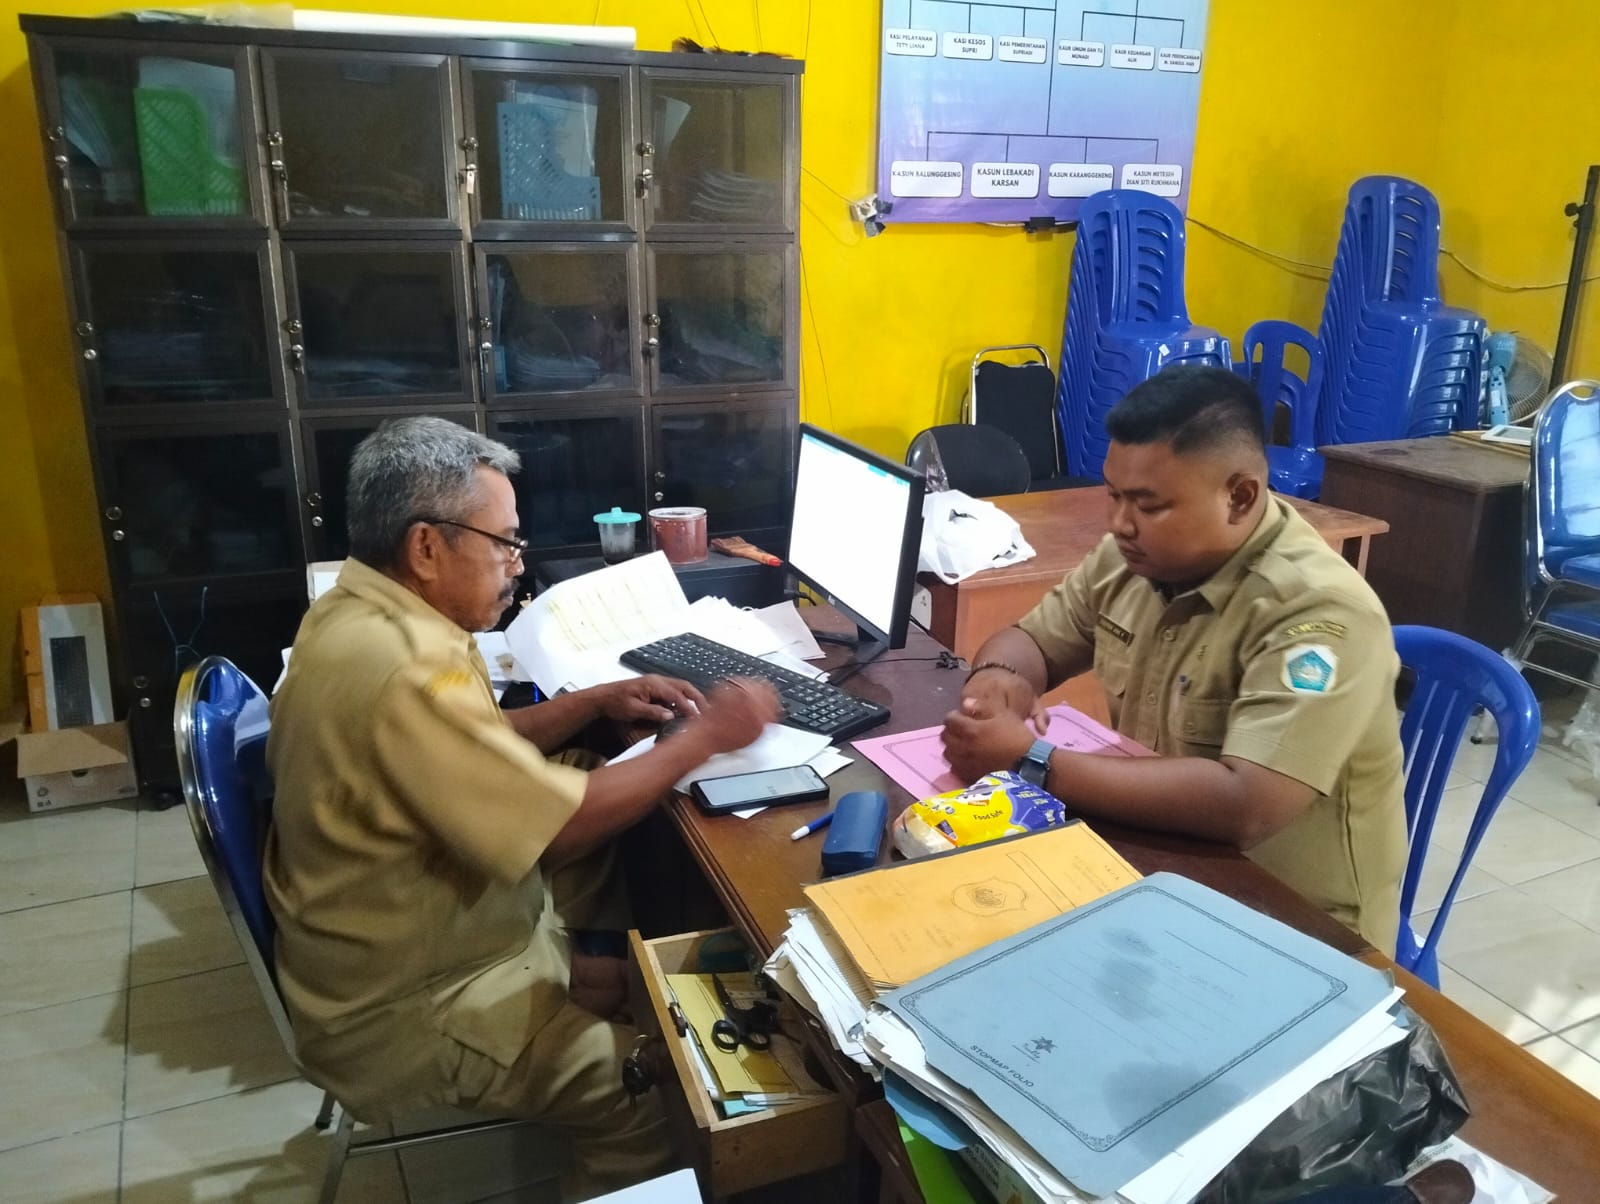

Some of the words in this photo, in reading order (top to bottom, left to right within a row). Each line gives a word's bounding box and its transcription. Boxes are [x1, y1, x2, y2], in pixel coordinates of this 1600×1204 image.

[968, 38, 986, 46] KESOS
[977, 168, 1000, 176] KASUN
[1002, 168, 1034, 177] LEBAKADI
[991, 179, 1020, 187] KARSAN
[973, 813, 990, 821] Food
[990, 809, 1003, 819] Safe
[969, 1044, 1010, 1070] STOPMAP
[1008, 1069, 1035, 1088] FOLIO
